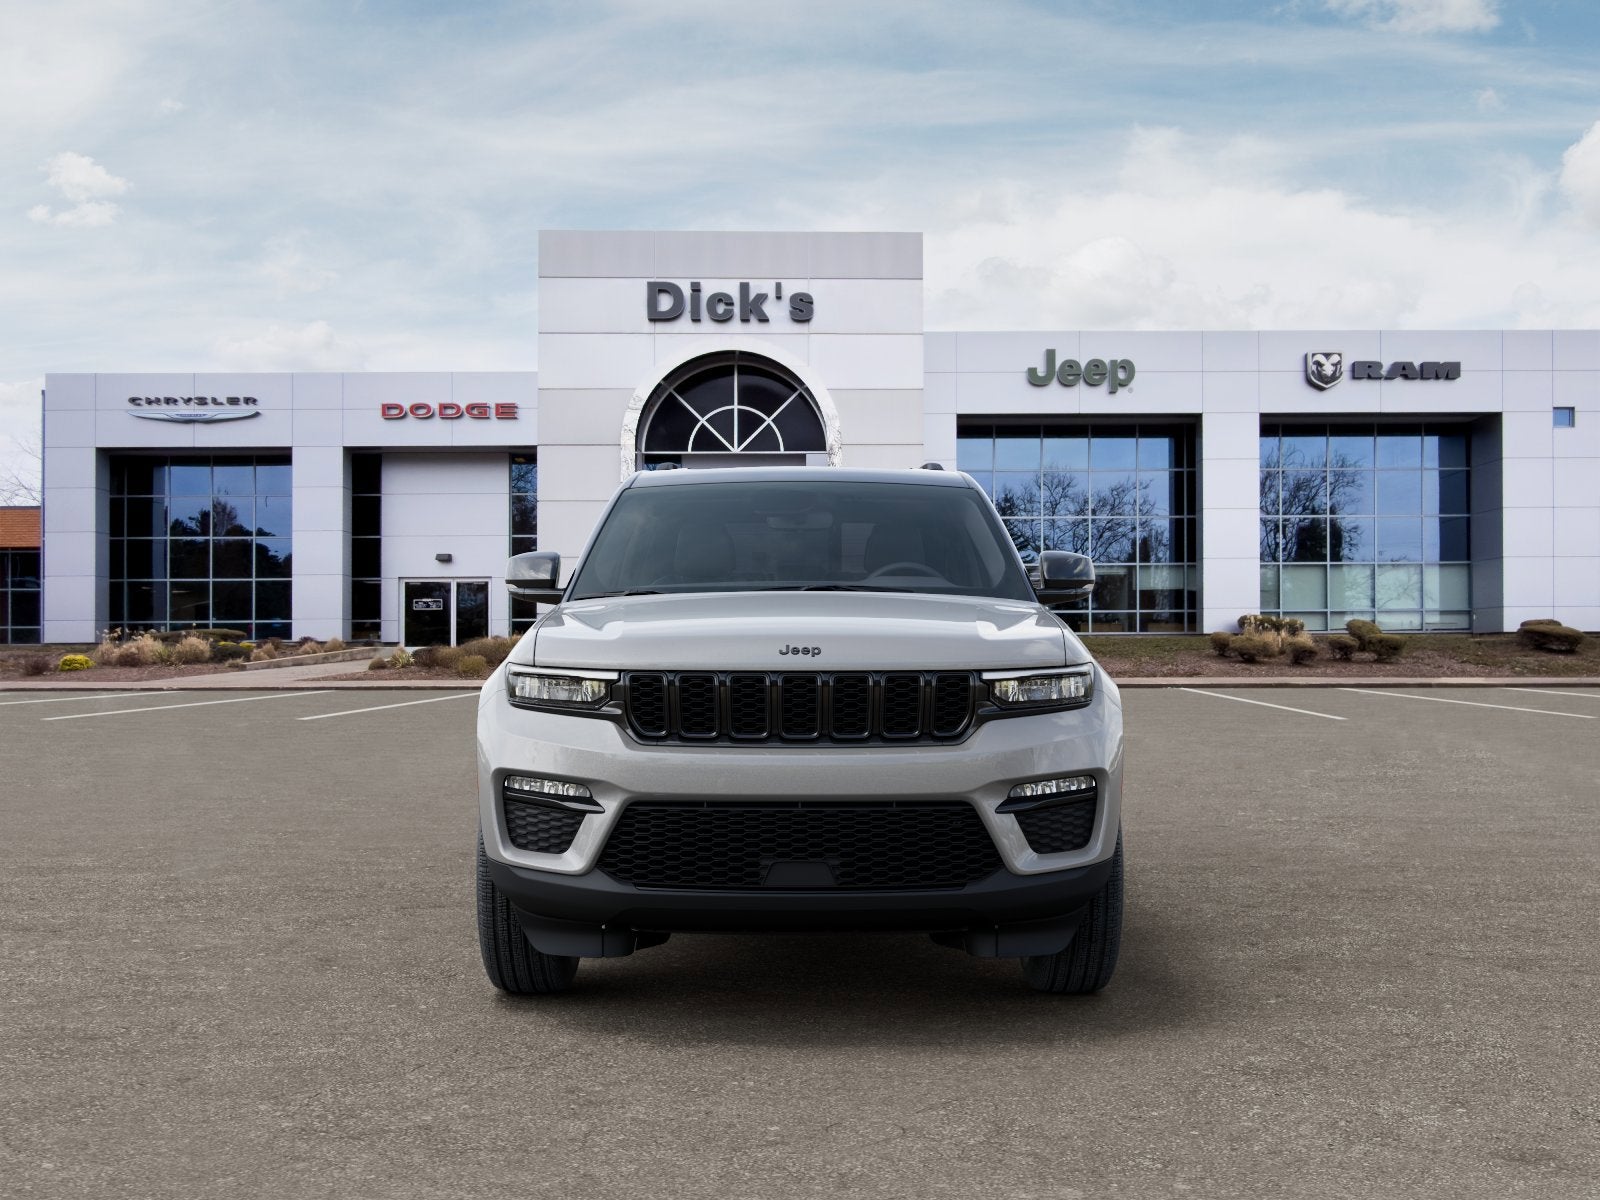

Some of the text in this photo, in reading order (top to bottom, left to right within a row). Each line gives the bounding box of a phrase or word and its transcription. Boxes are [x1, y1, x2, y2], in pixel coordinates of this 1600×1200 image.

[647, 281, 814, 322] Dick's
[1027, 348, 1136, 394] Jeep
[1352, 360, 1461, 380] RAM
[127, 396, 259, 407] CHRYSLER
[381, 402, 519, 420] DODGE
[778, 644, 822, 658] Jeep
